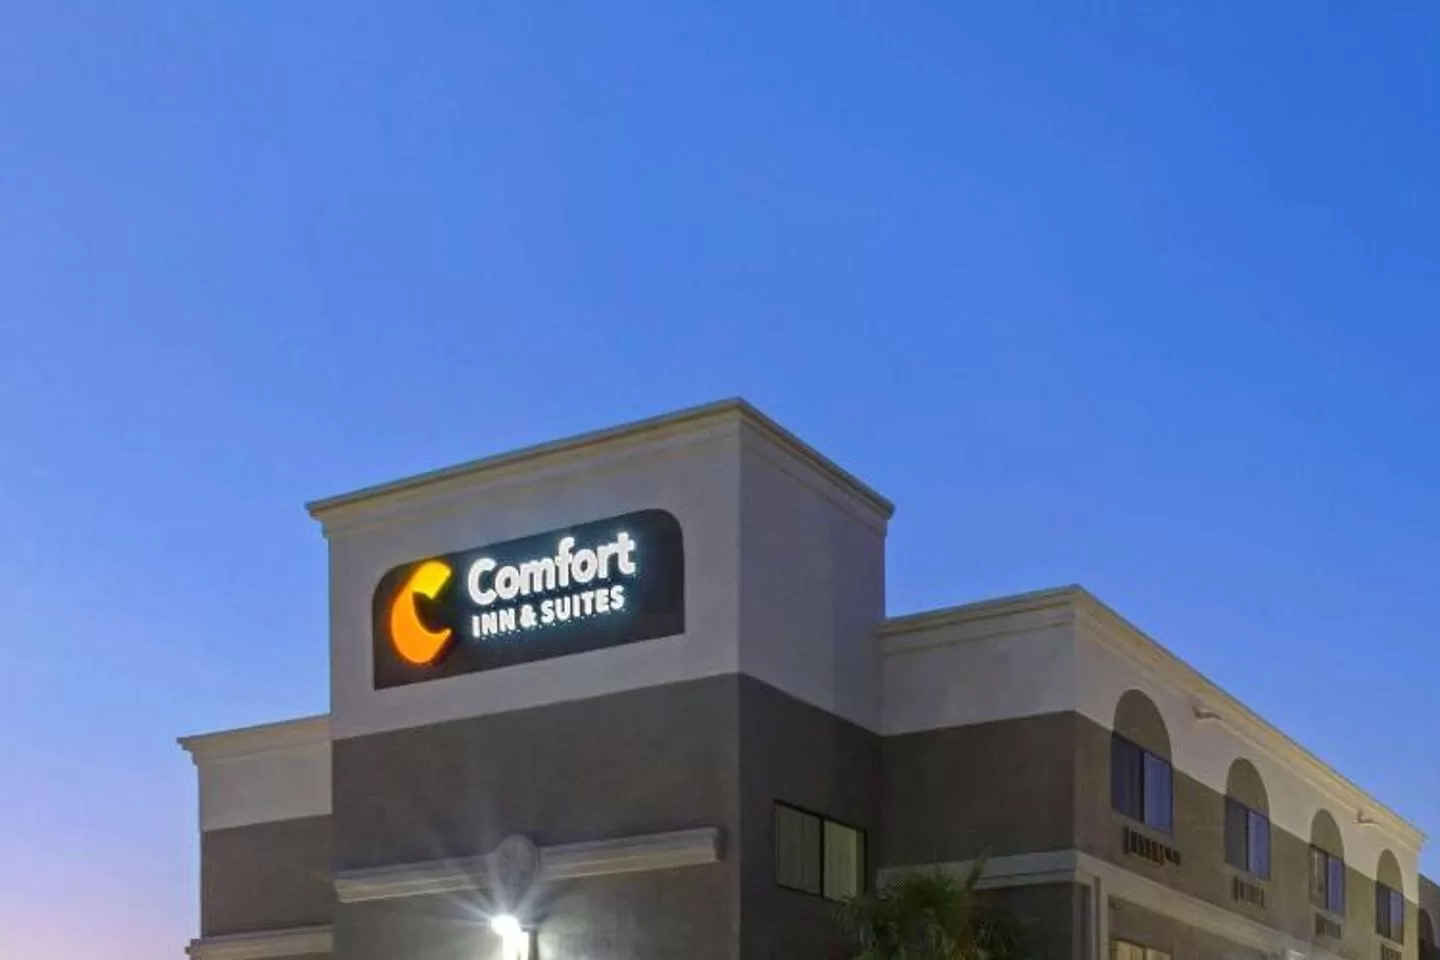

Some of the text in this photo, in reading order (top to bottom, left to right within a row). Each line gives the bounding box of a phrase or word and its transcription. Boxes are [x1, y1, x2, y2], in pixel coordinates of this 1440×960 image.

[468, 532, 636, 605] Comfort
[472, 585, 626, 638] INN & SUITES
